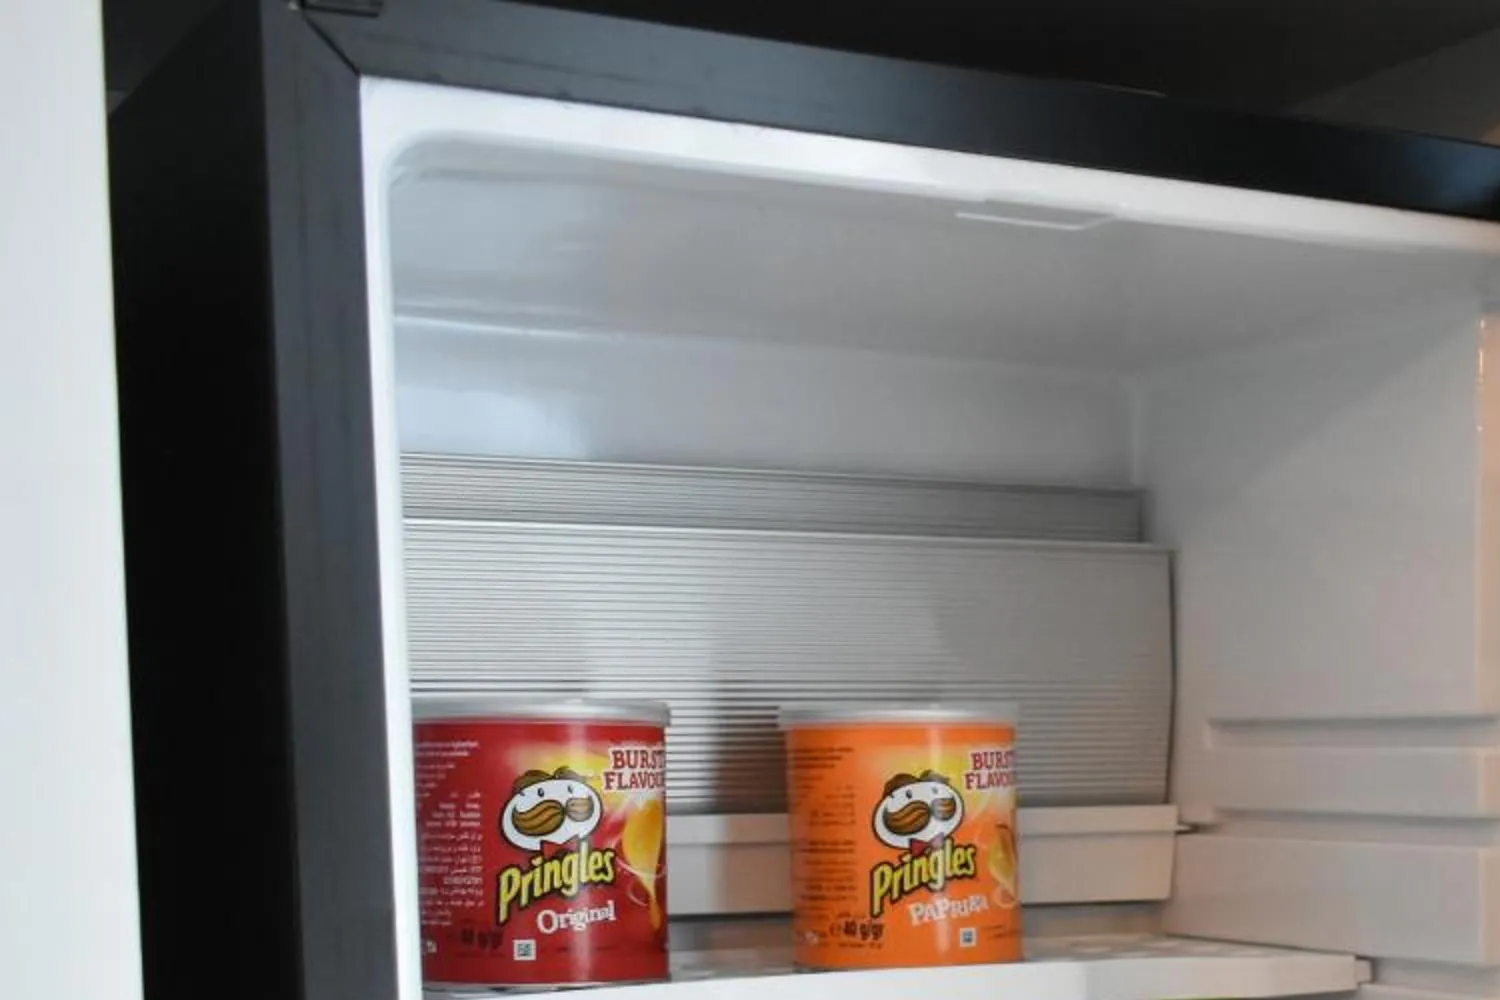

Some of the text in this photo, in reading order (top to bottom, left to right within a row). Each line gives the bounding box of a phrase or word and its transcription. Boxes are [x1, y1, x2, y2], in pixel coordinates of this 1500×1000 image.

[497, 841, 615, 926] Pringles
[536, 899, 616, 933] Original
[872, 840, 976, 916] Pringles
